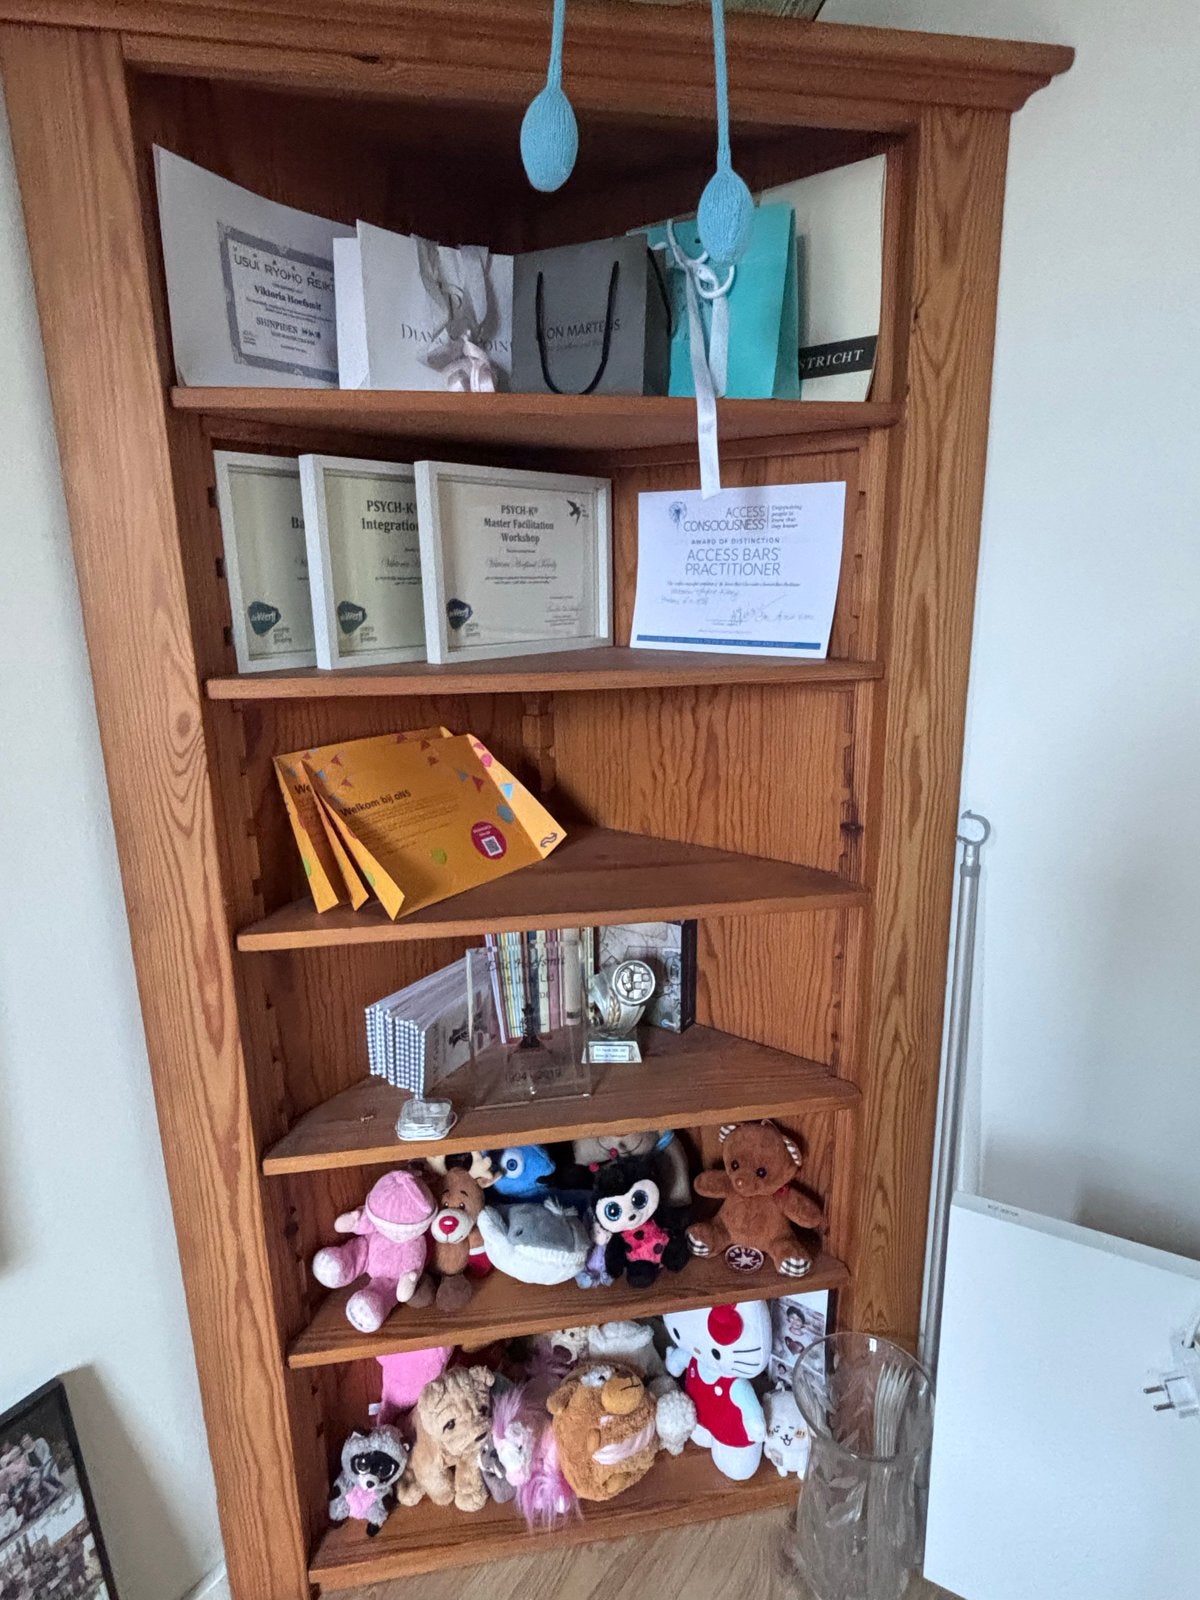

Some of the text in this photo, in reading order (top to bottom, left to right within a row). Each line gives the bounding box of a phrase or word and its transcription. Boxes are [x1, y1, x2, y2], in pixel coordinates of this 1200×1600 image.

[234, 254, 260, 272] USUI
[264, 264, 302, 284] RYOHO
[567, 318, 620, 337] MARTES
[725, 506, 766, 518] ACCESS
[484, 517, 554, 530] Master Facilitation
[501, 533, 540, 546] Workshop
[687, 548, 739, 561] ACCESS
[685, 562, 780, 576] PRACTITIONER
[340, 789, 411, 816] Welkom bij ons
